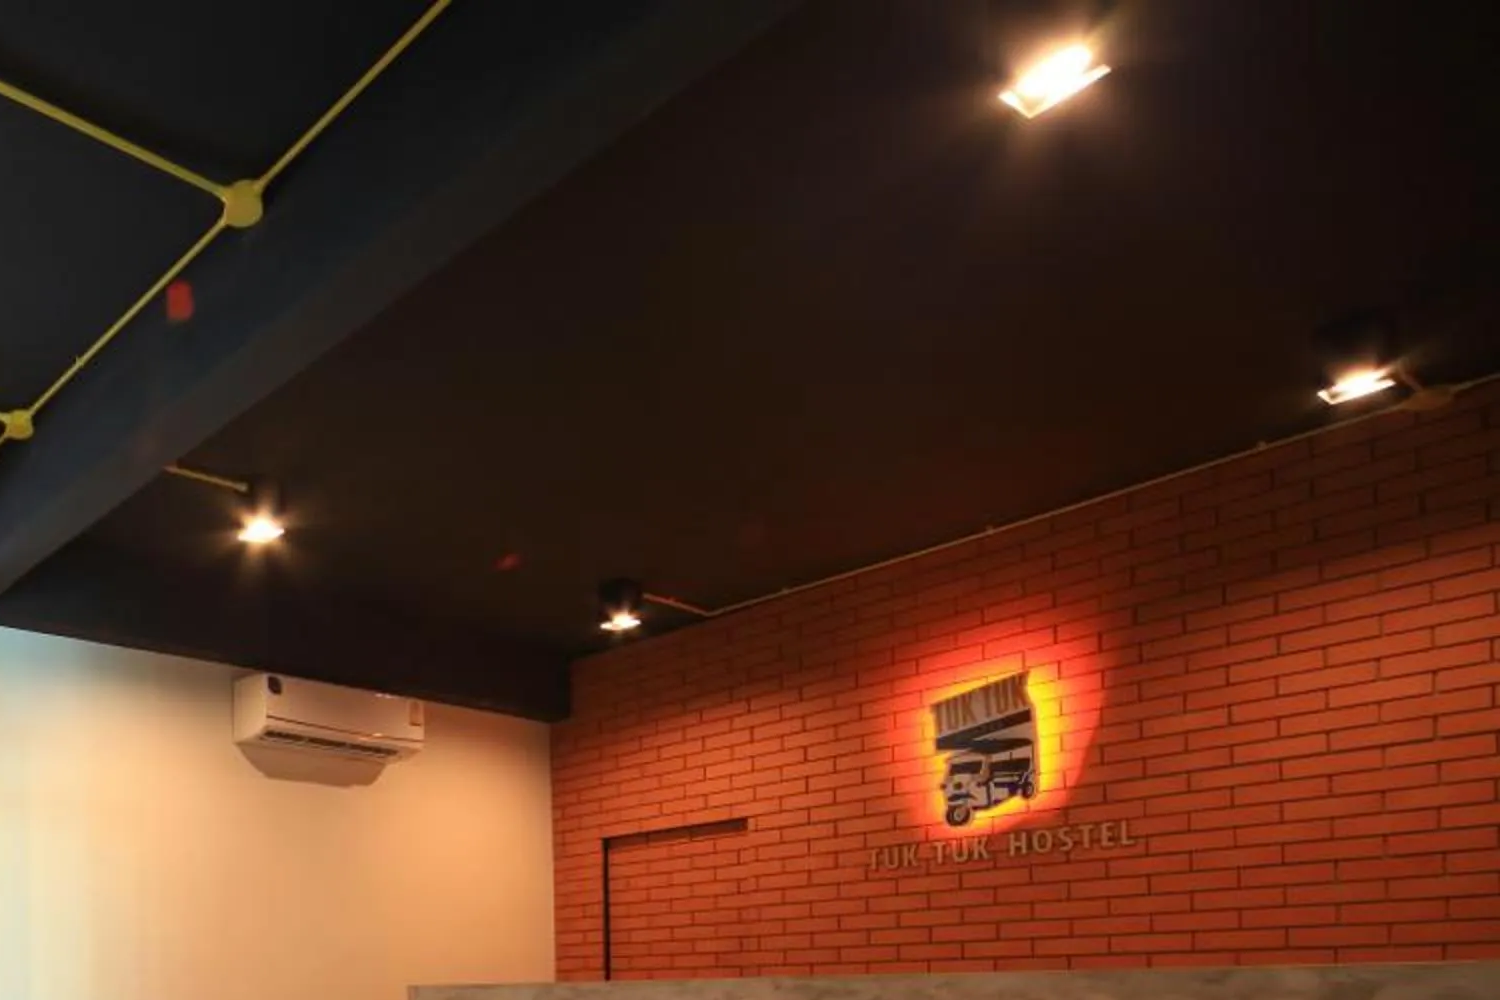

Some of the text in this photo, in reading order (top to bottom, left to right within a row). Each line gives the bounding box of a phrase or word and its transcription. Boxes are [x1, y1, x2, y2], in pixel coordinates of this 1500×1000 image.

[929, 671, 1030, 736] TUK TUK
[868, 819, 1137, 871] TUK TUK HOSTEL
